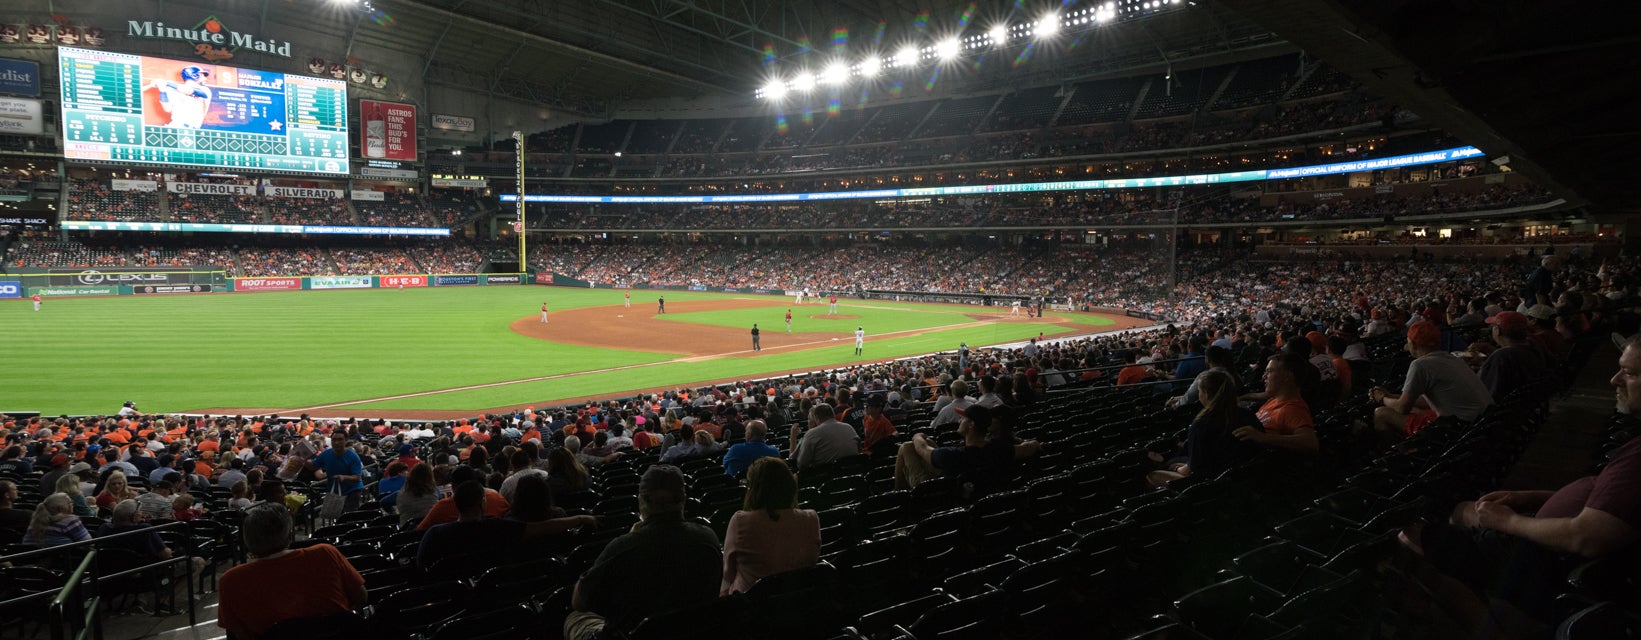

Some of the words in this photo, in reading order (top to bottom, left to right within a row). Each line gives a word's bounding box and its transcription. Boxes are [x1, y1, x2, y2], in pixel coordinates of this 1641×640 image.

[128, 20, 224, 44] Minute
[231, 31, 291, 57] Maid
[388, 109, 412, 118] ASTROS
[388, 116, 406, 124] FANS,
[1302, 166, 1327, 175] OFFICIAL
[1328, 163, 1356, 172] UNIFORM
[1367, 159, 1388, 168] MAJOR
[1389, 156, 1413, 166] LEAGUE
[1414, 153, 1447, 162] BASEBALL
[176, 183, 248, 195] CHEVROLET
[275, 188, 336, 198] SILVERADO
[106, 273, 167, 281] LEXUS
